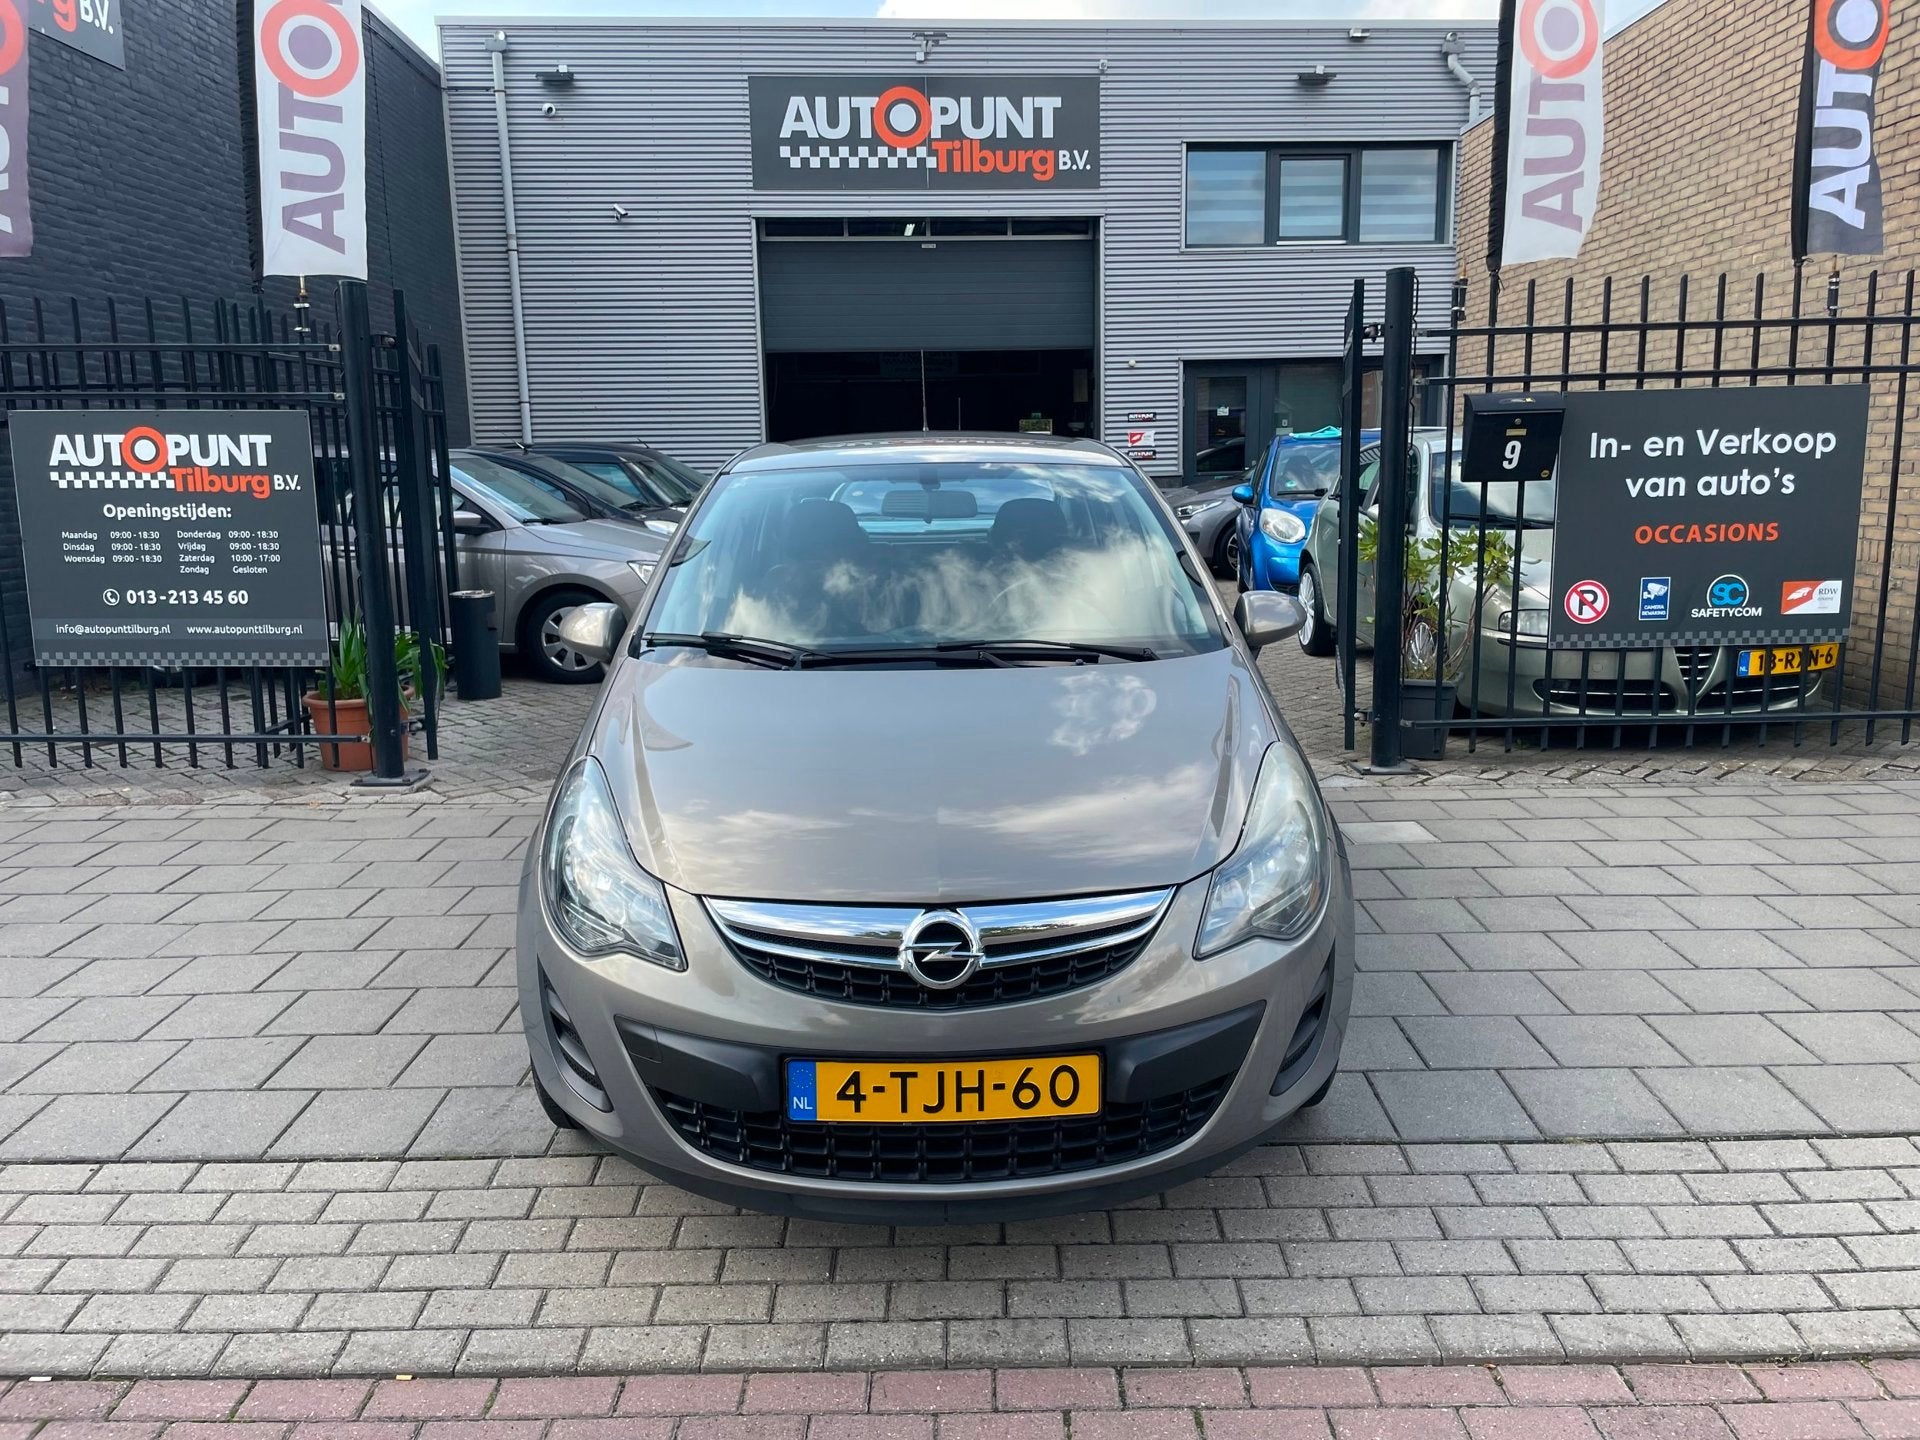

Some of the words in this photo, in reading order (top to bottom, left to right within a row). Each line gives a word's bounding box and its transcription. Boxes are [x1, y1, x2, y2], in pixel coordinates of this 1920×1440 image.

[779, 86, 1062, 148] AUTOPUNT
[261, 0, 359, 256] AUTO
[932, 139, 1056, 182] Tilburg
[1058, 150, 1092, 171] B.V.
[49, 426, 272, 474] AUTOPUNT
[1590, 432, 1631, 458] In-
[1643, 436, 1684, 457] en
[1696, 427, 1837, 459] Verkoop
[1502, 440, 1522, 470] 9
[170, 466, 272, 499] Tilburg
[273, 474, 302, 491] B.V.
[1625, 475, 1686, 498] van
[1697, 467, 1796, 496] auto's
[103, 503, 232, 520] Openingstijden:
[61, 531, 98, 540] Maandag
[110, 531, 132, 539] 09:00
[138, 531, 160, 539] 18:30
[177, 530, 221, 540] Donderdag
[1634, 522, 1779, 544] OCCASIONS
[63, 543, 95, 552] Dinsdag
[178, 542, 206, 551] Vrijdag
[64, 554, 105, 564] Woensdag
[179, 554, 215, 563] Zaterdag
[180, 566, 209, 575] Zondag
[203, 590, 224, 605] 45
[228, 590, 249, 605] 60
[1691, 607, 1762, 618] SAFETYCOM
[56, 624, 171, 636] info@autopunttilburg.nl
[186, 624, 303, 636] www.autopunttilburg.nl
[793, 1097, 813, 1110] NL
[836, 1064, 1080, 1114] 4-TJH-60
